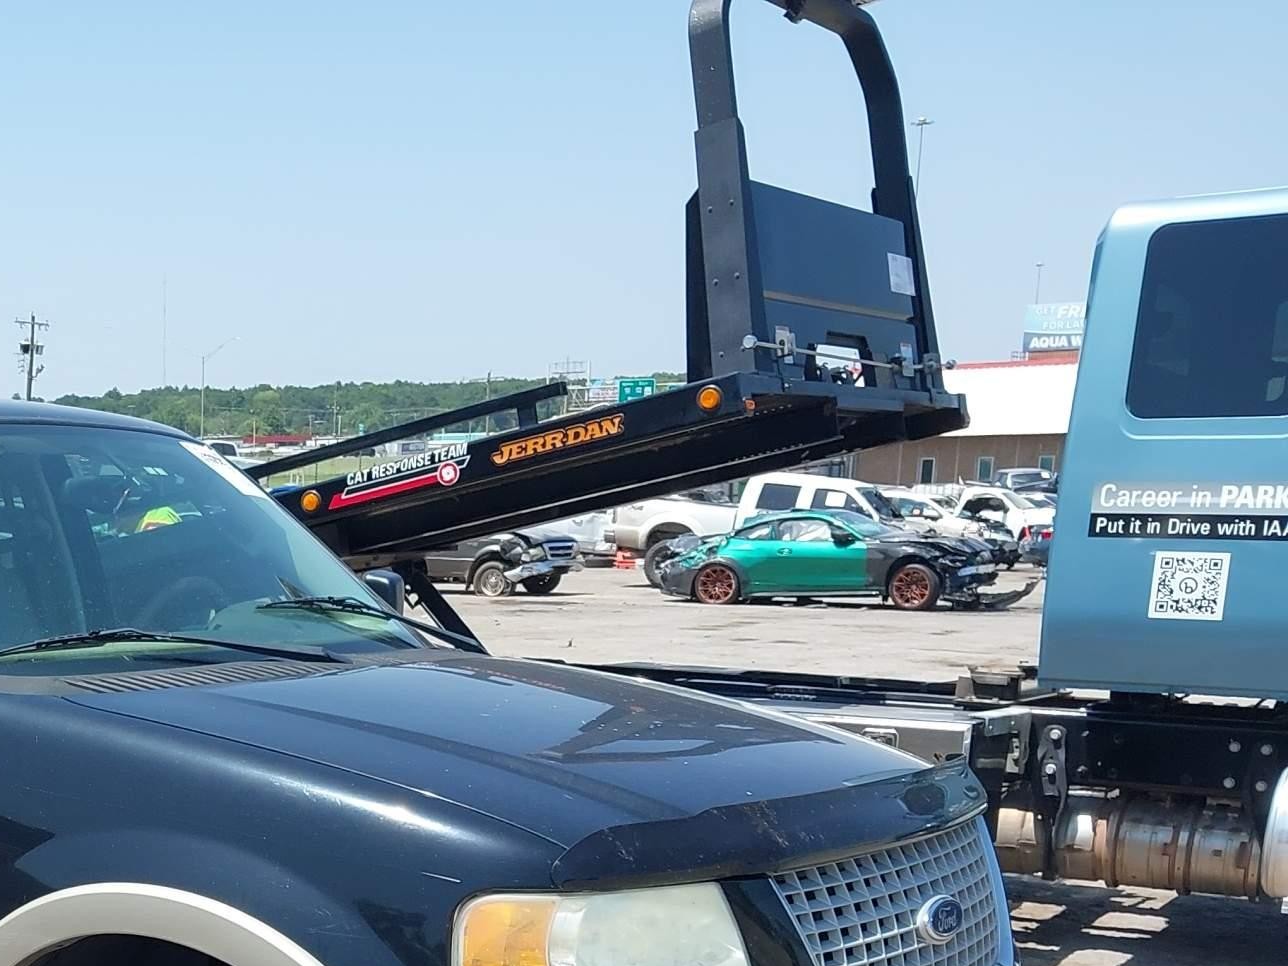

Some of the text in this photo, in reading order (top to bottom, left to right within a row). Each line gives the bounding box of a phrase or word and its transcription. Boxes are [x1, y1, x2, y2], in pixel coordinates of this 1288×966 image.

[1042, 320, 1064, 330] FOR
[1029, 335, 1068, 348] AQUA
[347, 442, 468, 485] CAT RESPONSE TEAM
[1099, 483, 1183, 508] Career
[1189, 485, 1212, 508] in
[1095, 517, 1125, 534] Put
[1129, 517, 1142, 534] it
[1146, 518, 1161, 534] in
[1167, 518, 1211, 535] Drive
[1217, 518, 1255, 536] with
